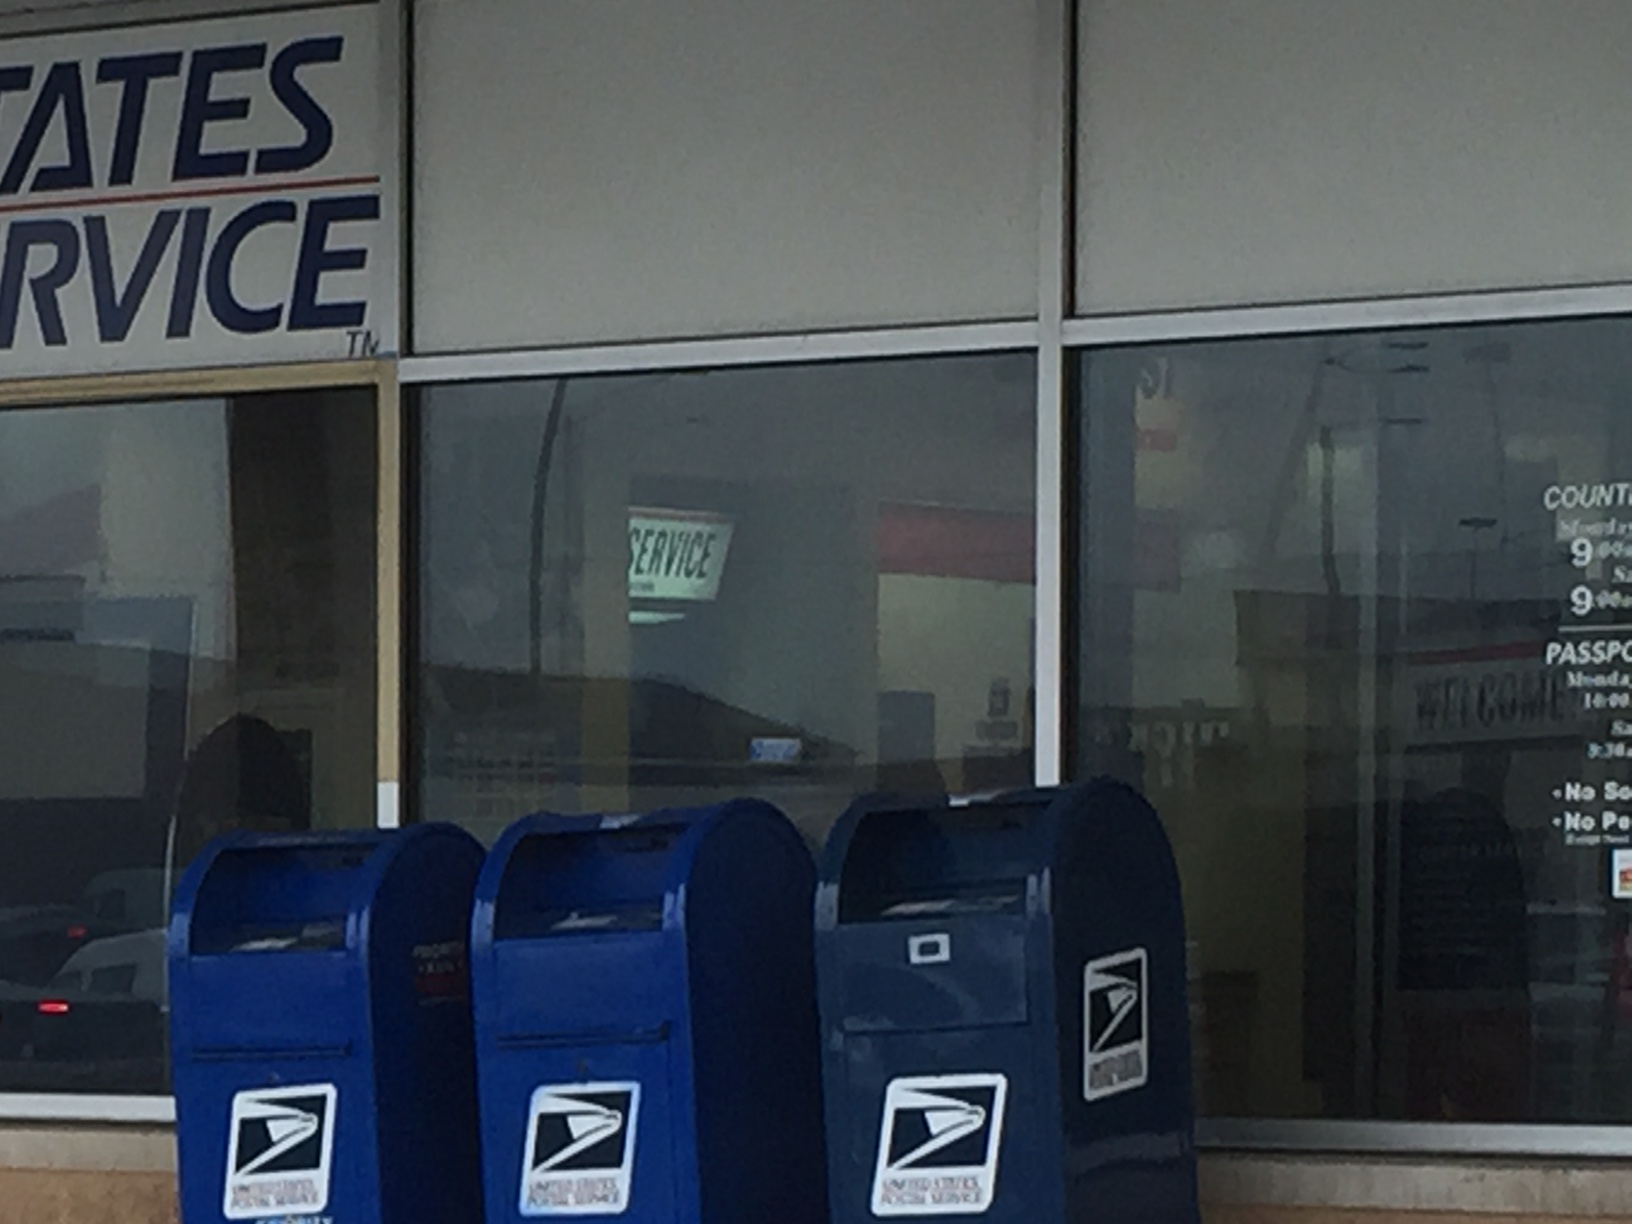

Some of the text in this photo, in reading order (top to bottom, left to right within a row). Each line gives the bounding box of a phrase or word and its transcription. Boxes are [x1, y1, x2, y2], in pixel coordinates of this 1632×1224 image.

[1544, 483, 1632, 511] COUNT
[1565, 782, 1596, 801] No
[1564, 811, 1596, 831] No
